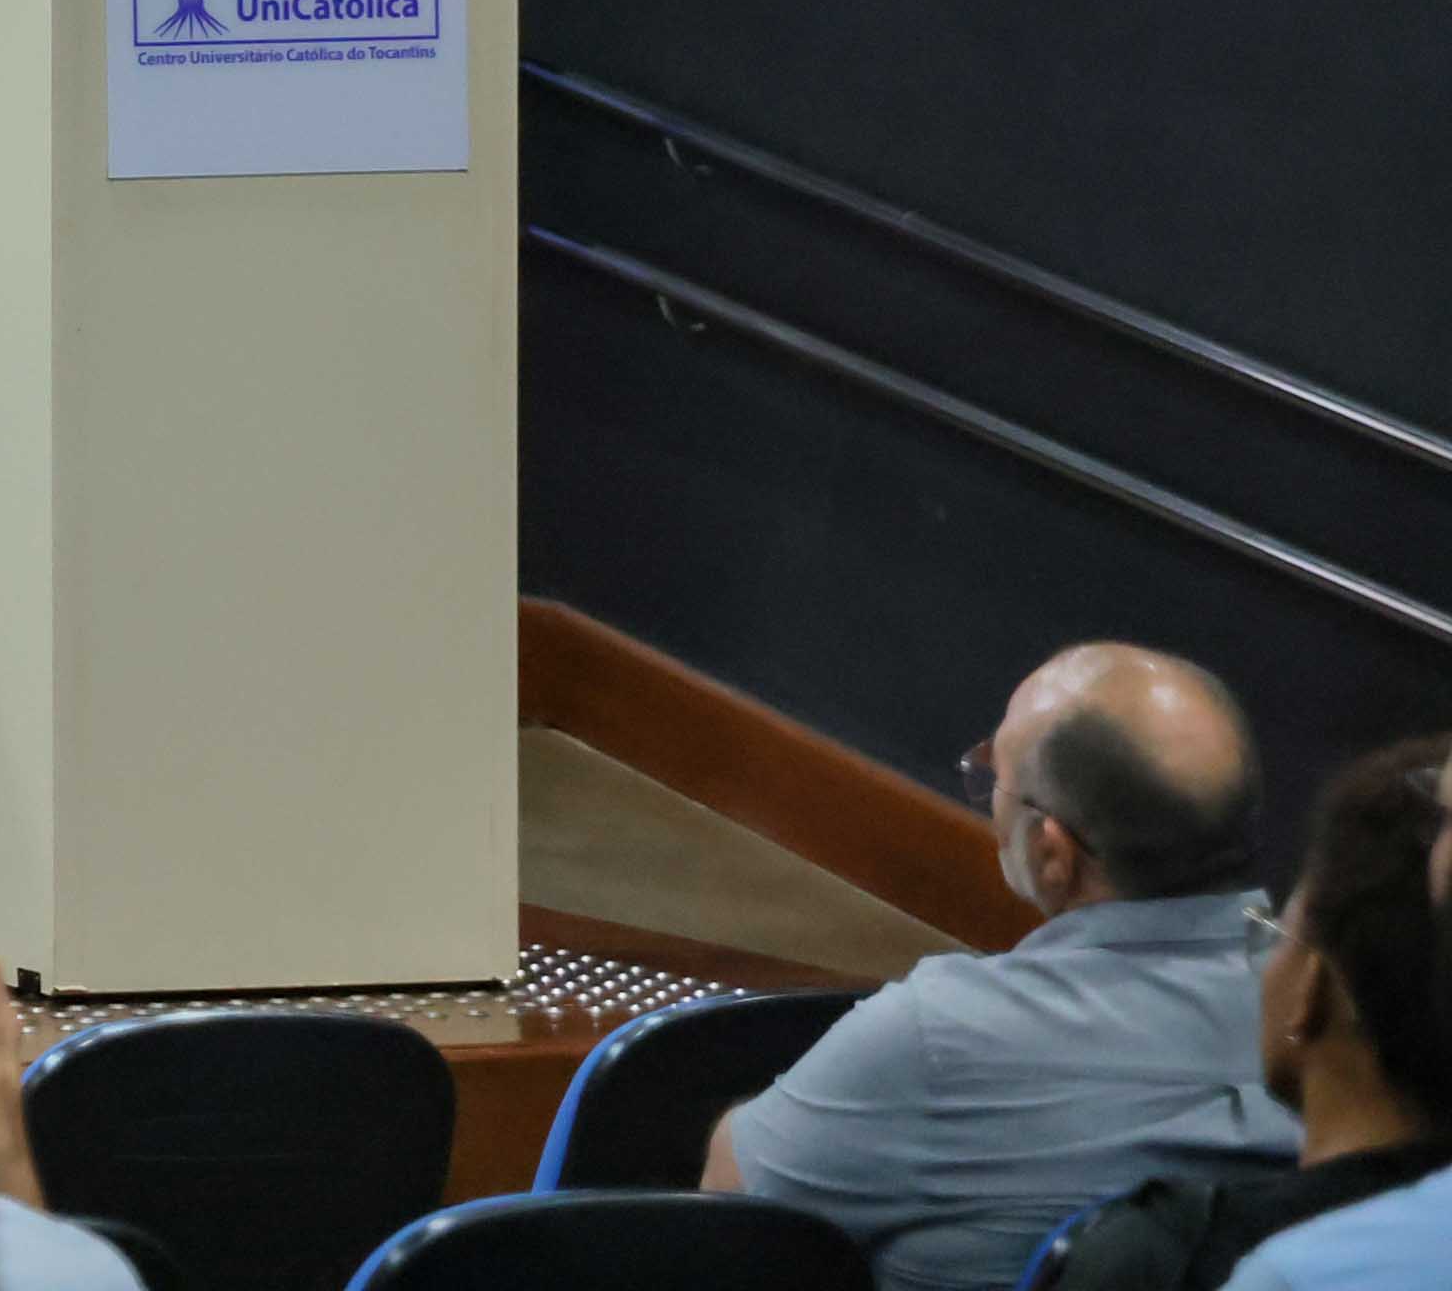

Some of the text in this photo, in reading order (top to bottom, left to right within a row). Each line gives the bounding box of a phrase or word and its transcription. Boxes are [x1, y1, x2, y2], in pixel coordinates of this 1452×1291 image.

[137, 44, 437, 67] Centro Universitário Católica do Tocantins
